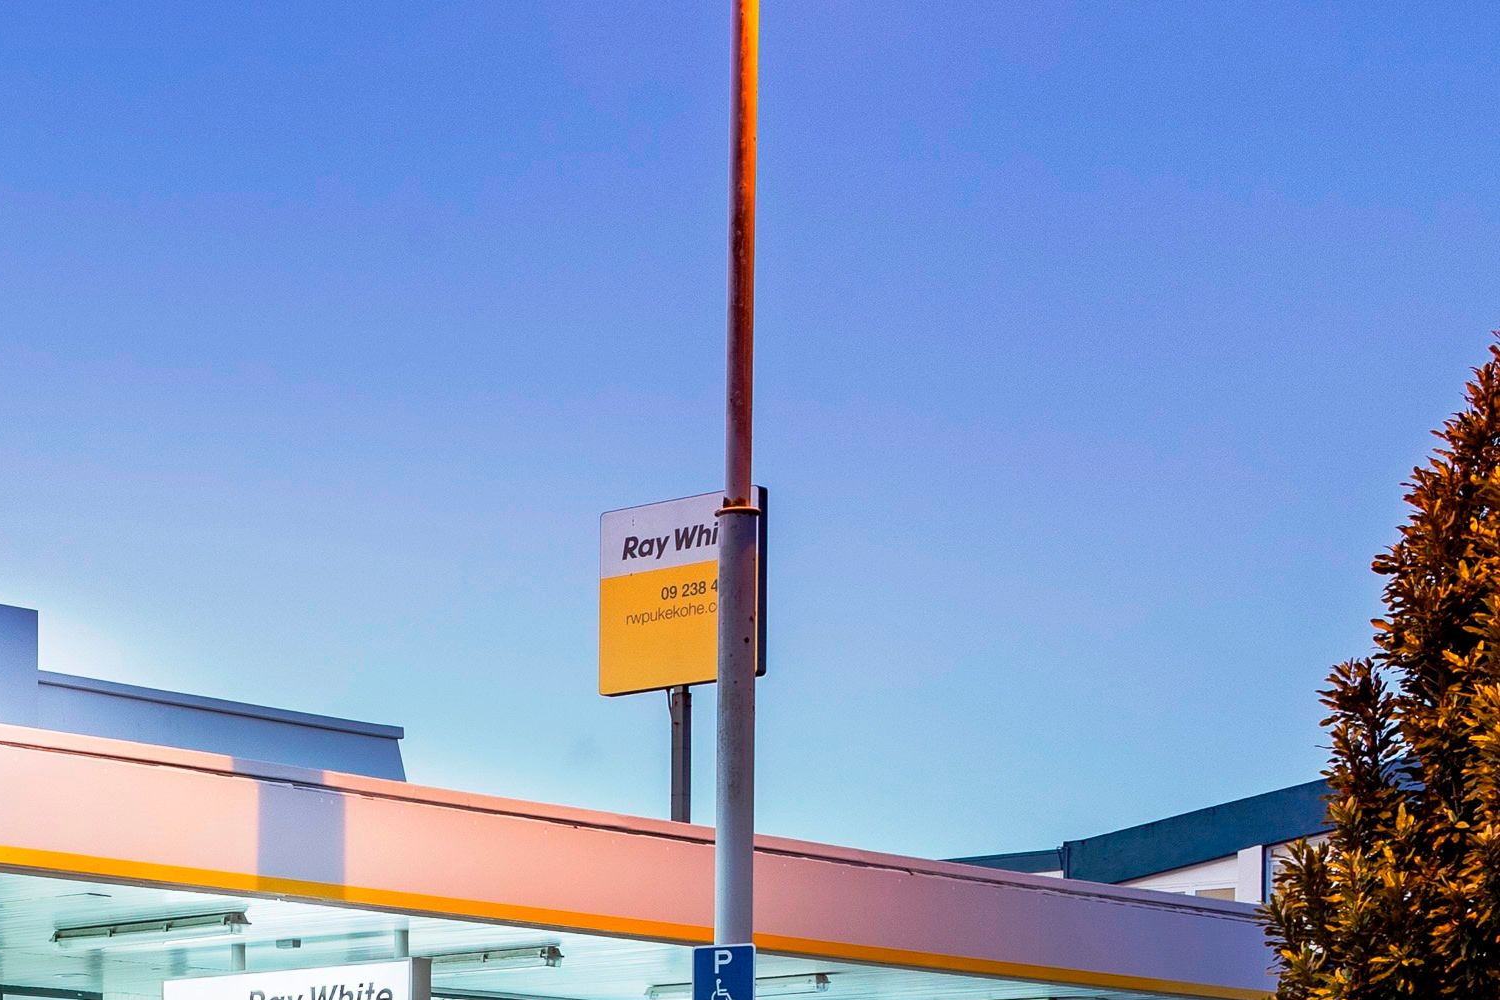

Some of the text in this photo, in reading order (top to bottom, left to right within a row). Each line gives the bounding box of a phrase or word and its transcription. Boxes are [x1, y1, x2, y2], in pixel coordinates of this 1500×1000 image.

[621, 522, 718, 560] Ray Whi
[660, 584, 677, 601] 09
[681, 580, 706, 598] 238
[626, 601, 717, 625] rwpukekohe.c
[714, 949, 732, 974] P
